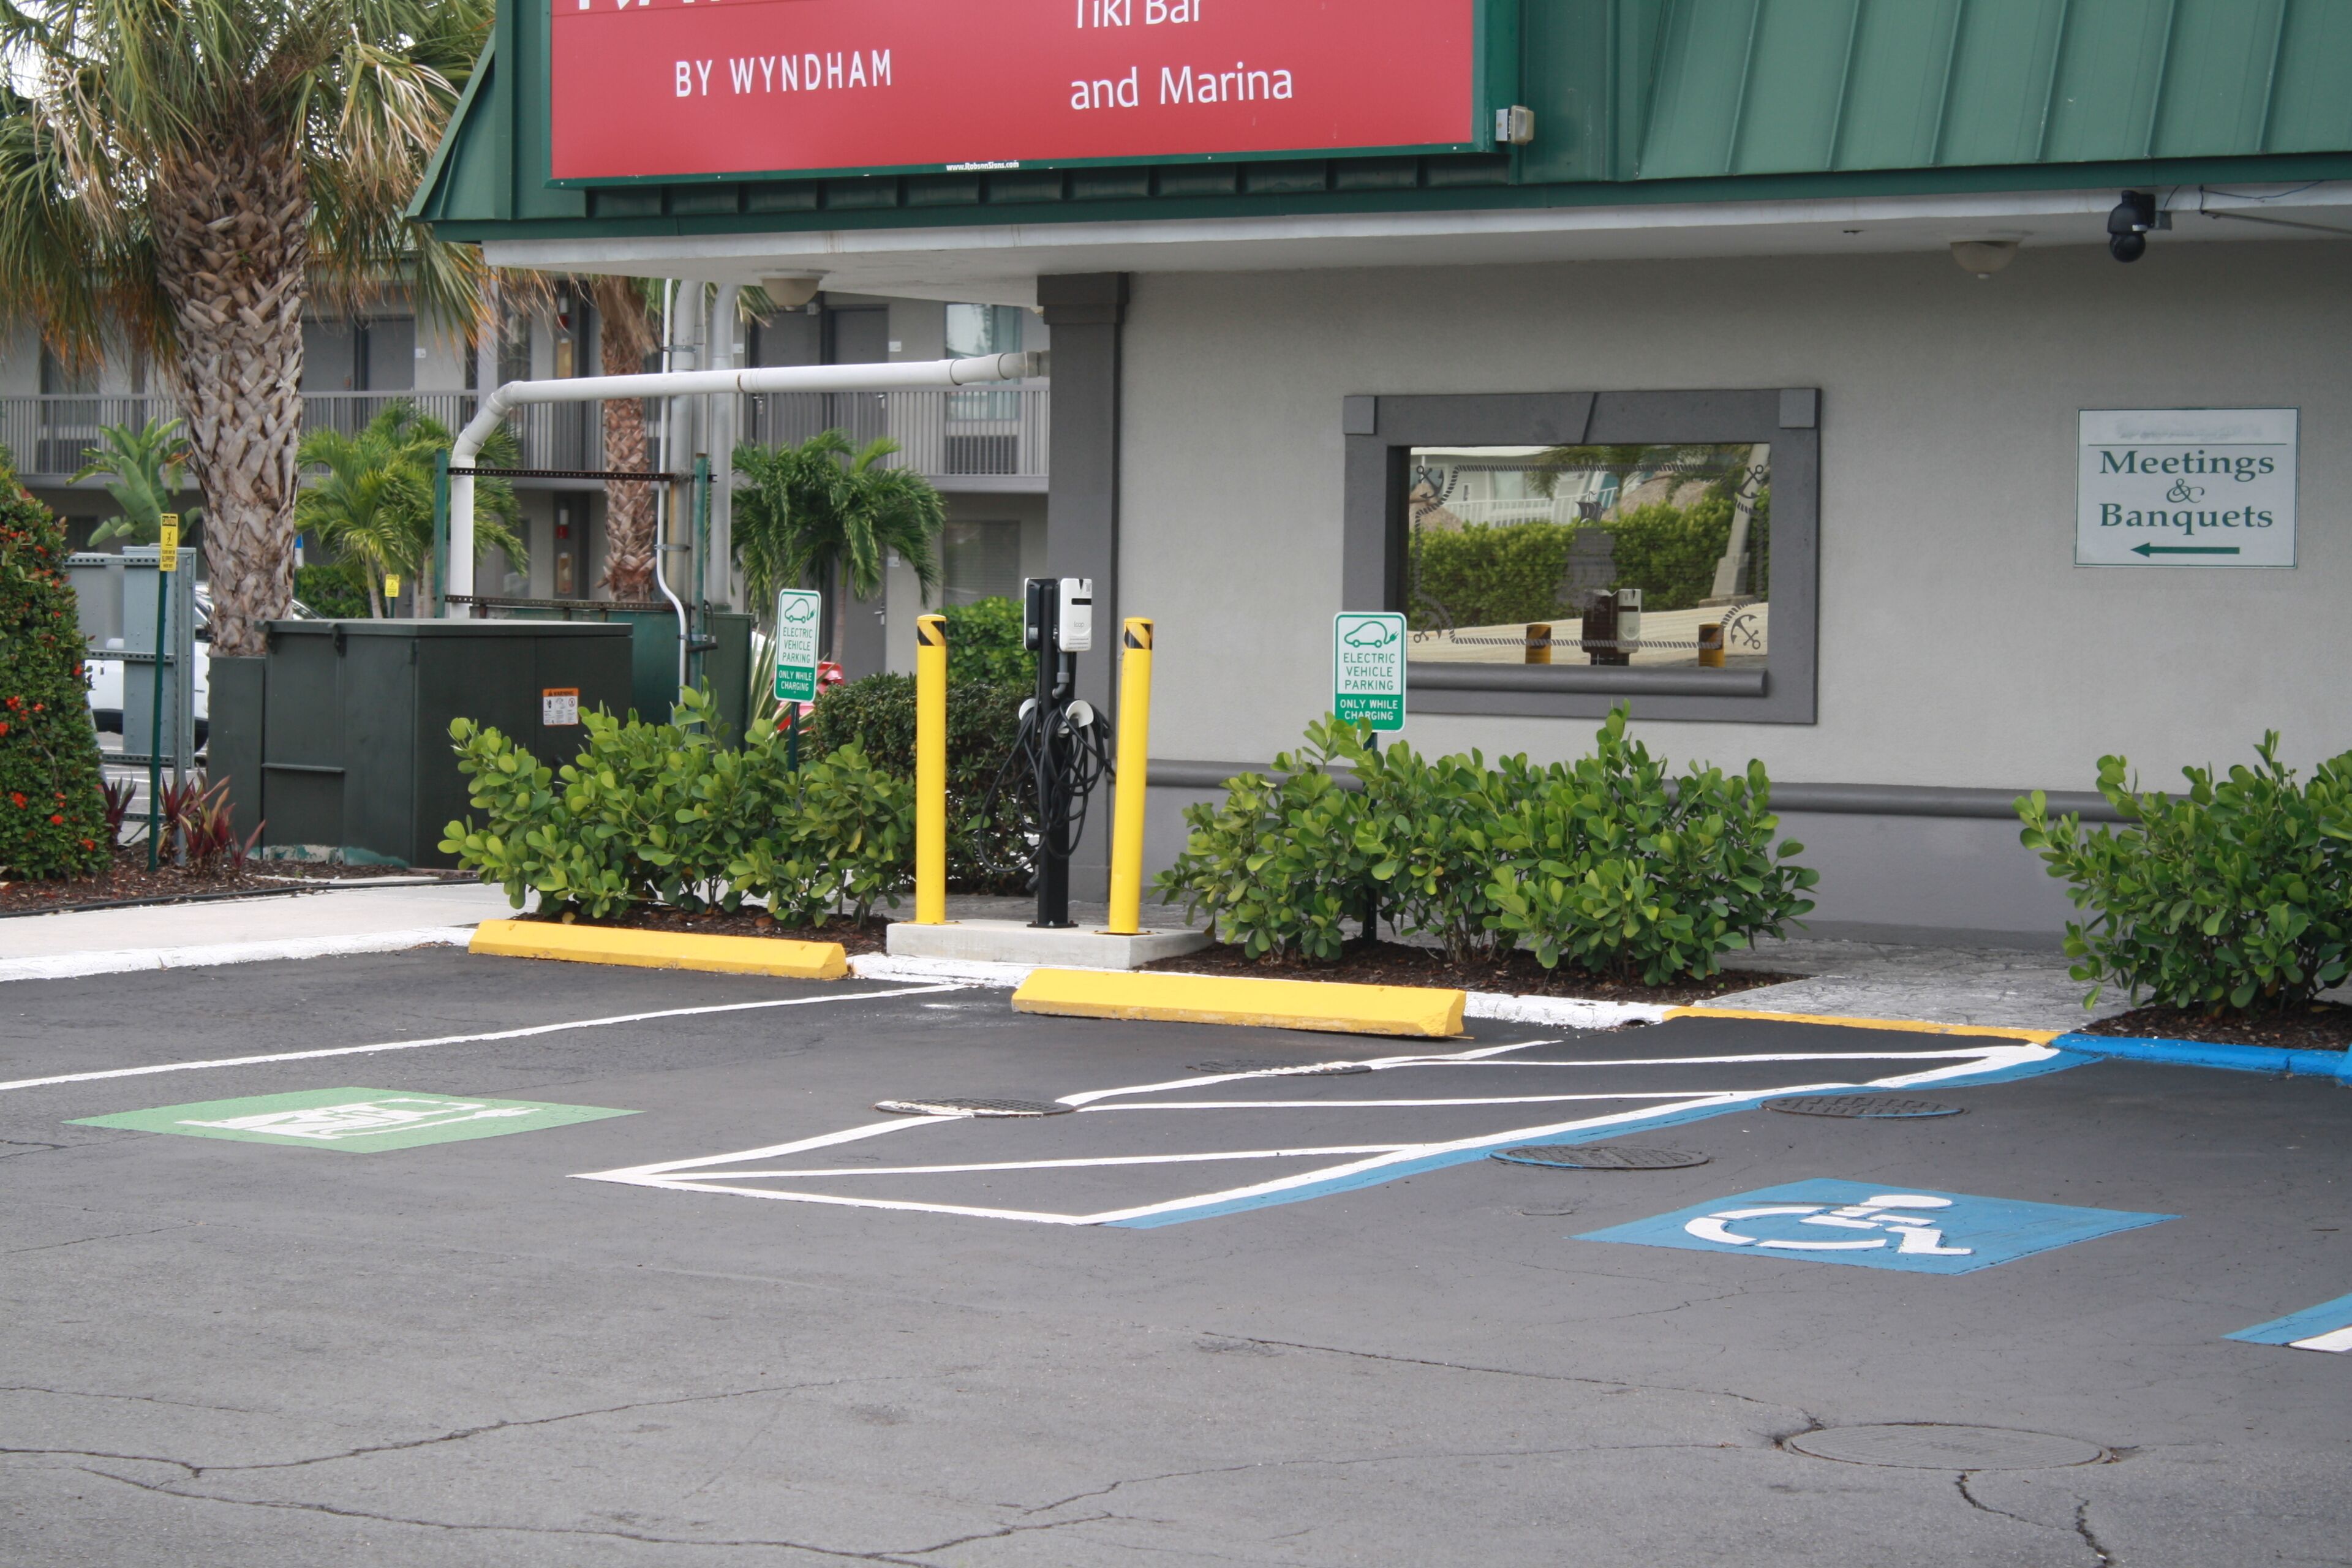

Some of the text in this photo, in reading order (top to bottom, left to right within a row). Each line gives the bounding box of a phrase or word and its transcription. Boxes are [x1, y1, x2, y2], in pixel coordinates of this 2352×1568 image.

[1146, 0, 1200, 24] Bar
[676, 49, 892, 97] BY WYNDHAM
[1071, 61, 1293, 110] and Marina
[2099, 449, 2275, 483] Meetings
[2166, 478, 2205, 503] &
[2099, 503, 2273, 535] Banquets
[783, 627, 813, 638] ELECTRIC
[784, 640, 811, 651] VEHICLE
[782, 652, 810, 663] PARKING
[1343, 652, 1395, 663] ELECTRIC
[778, 670, 812, 681] ONLY WHILE
[1346, 666, 1393, 677] VEHICLE
[781, 681, 809, 692] CHARGING
[1344, 680, 1393, 690] PARKING
[1340, 699, 1398, 709] ONLY WHILE
[1344, 710, 1393, 720] CHARGING
